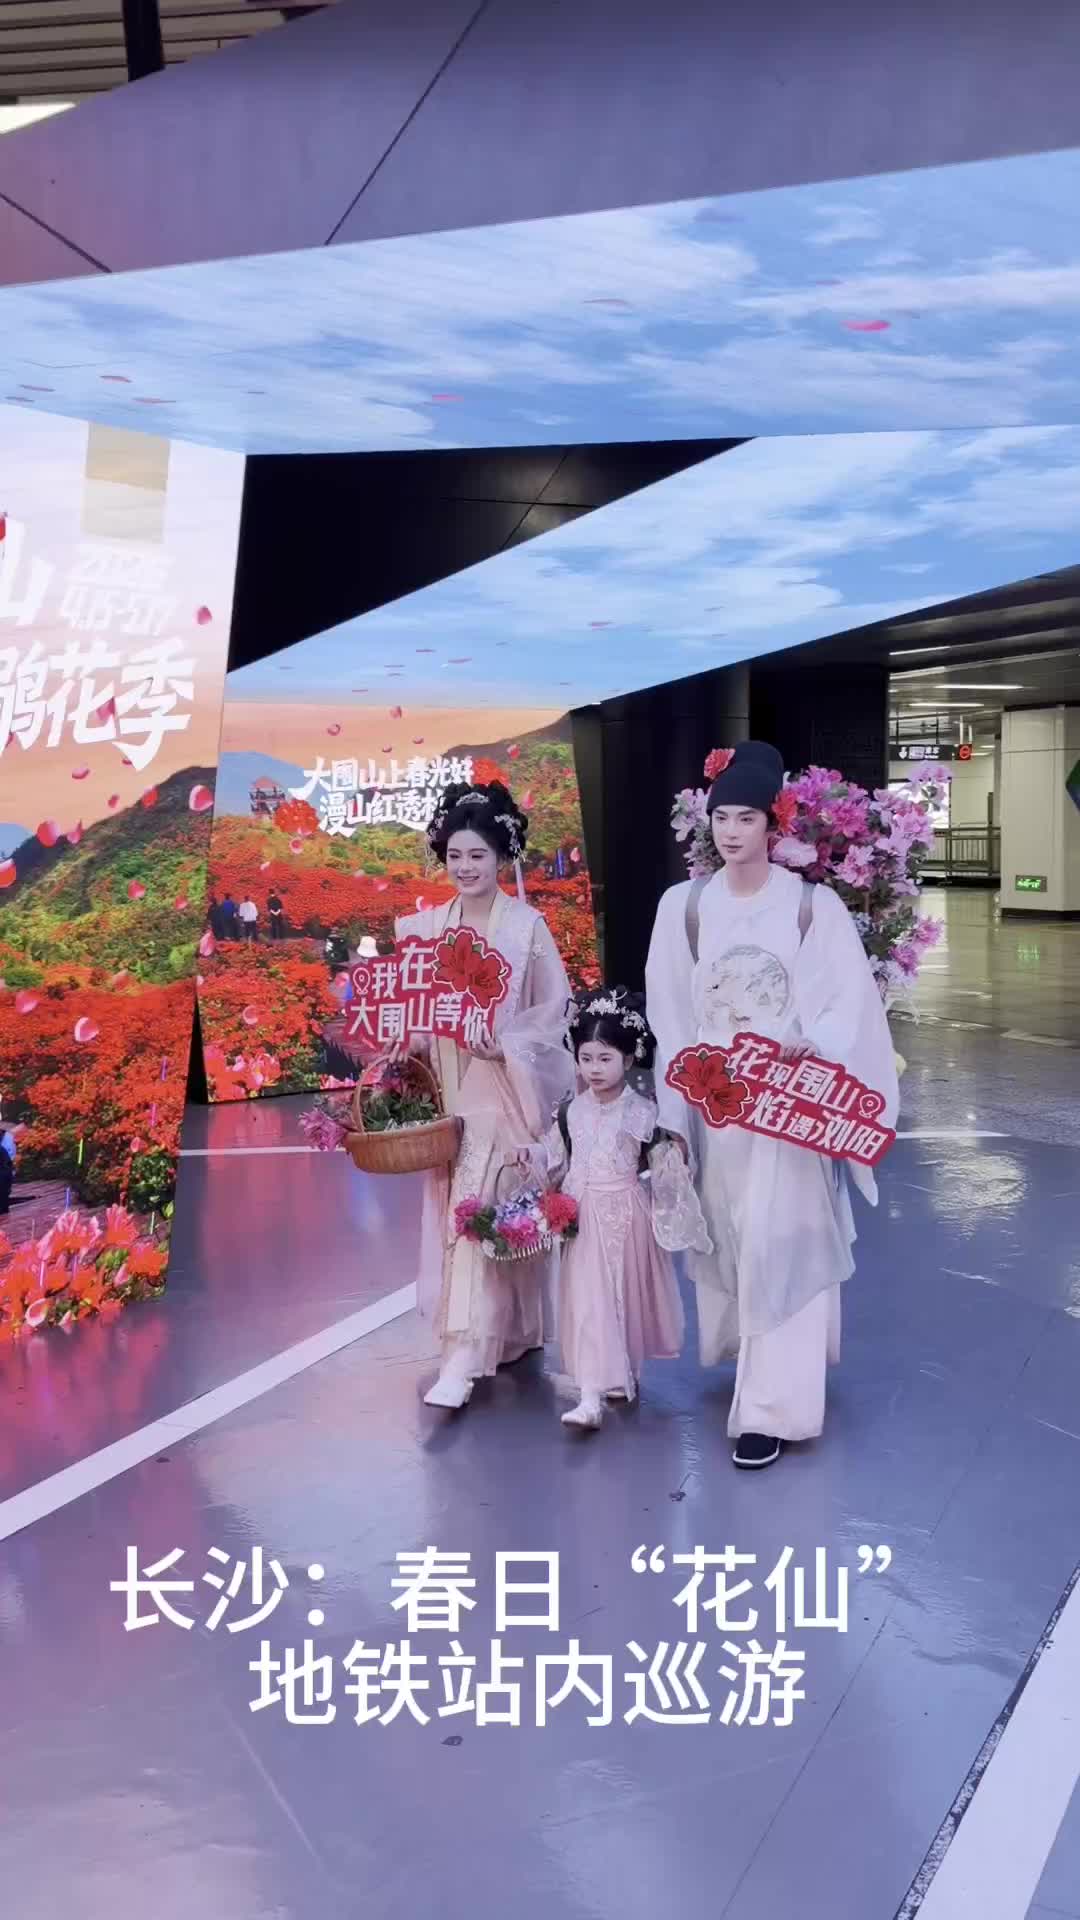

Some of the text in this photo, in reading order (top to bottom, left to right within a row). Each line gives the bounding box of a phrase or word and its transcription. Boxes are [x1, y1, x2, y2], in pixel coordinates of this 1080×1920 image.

[372, 943, 435, 1000] 我在
[348, 993, 490, 1050] 大围山等你
[727, 1038, 860, 1113] 花现围山
[745, 1090, 889, 1160] 焰遇浏阳
